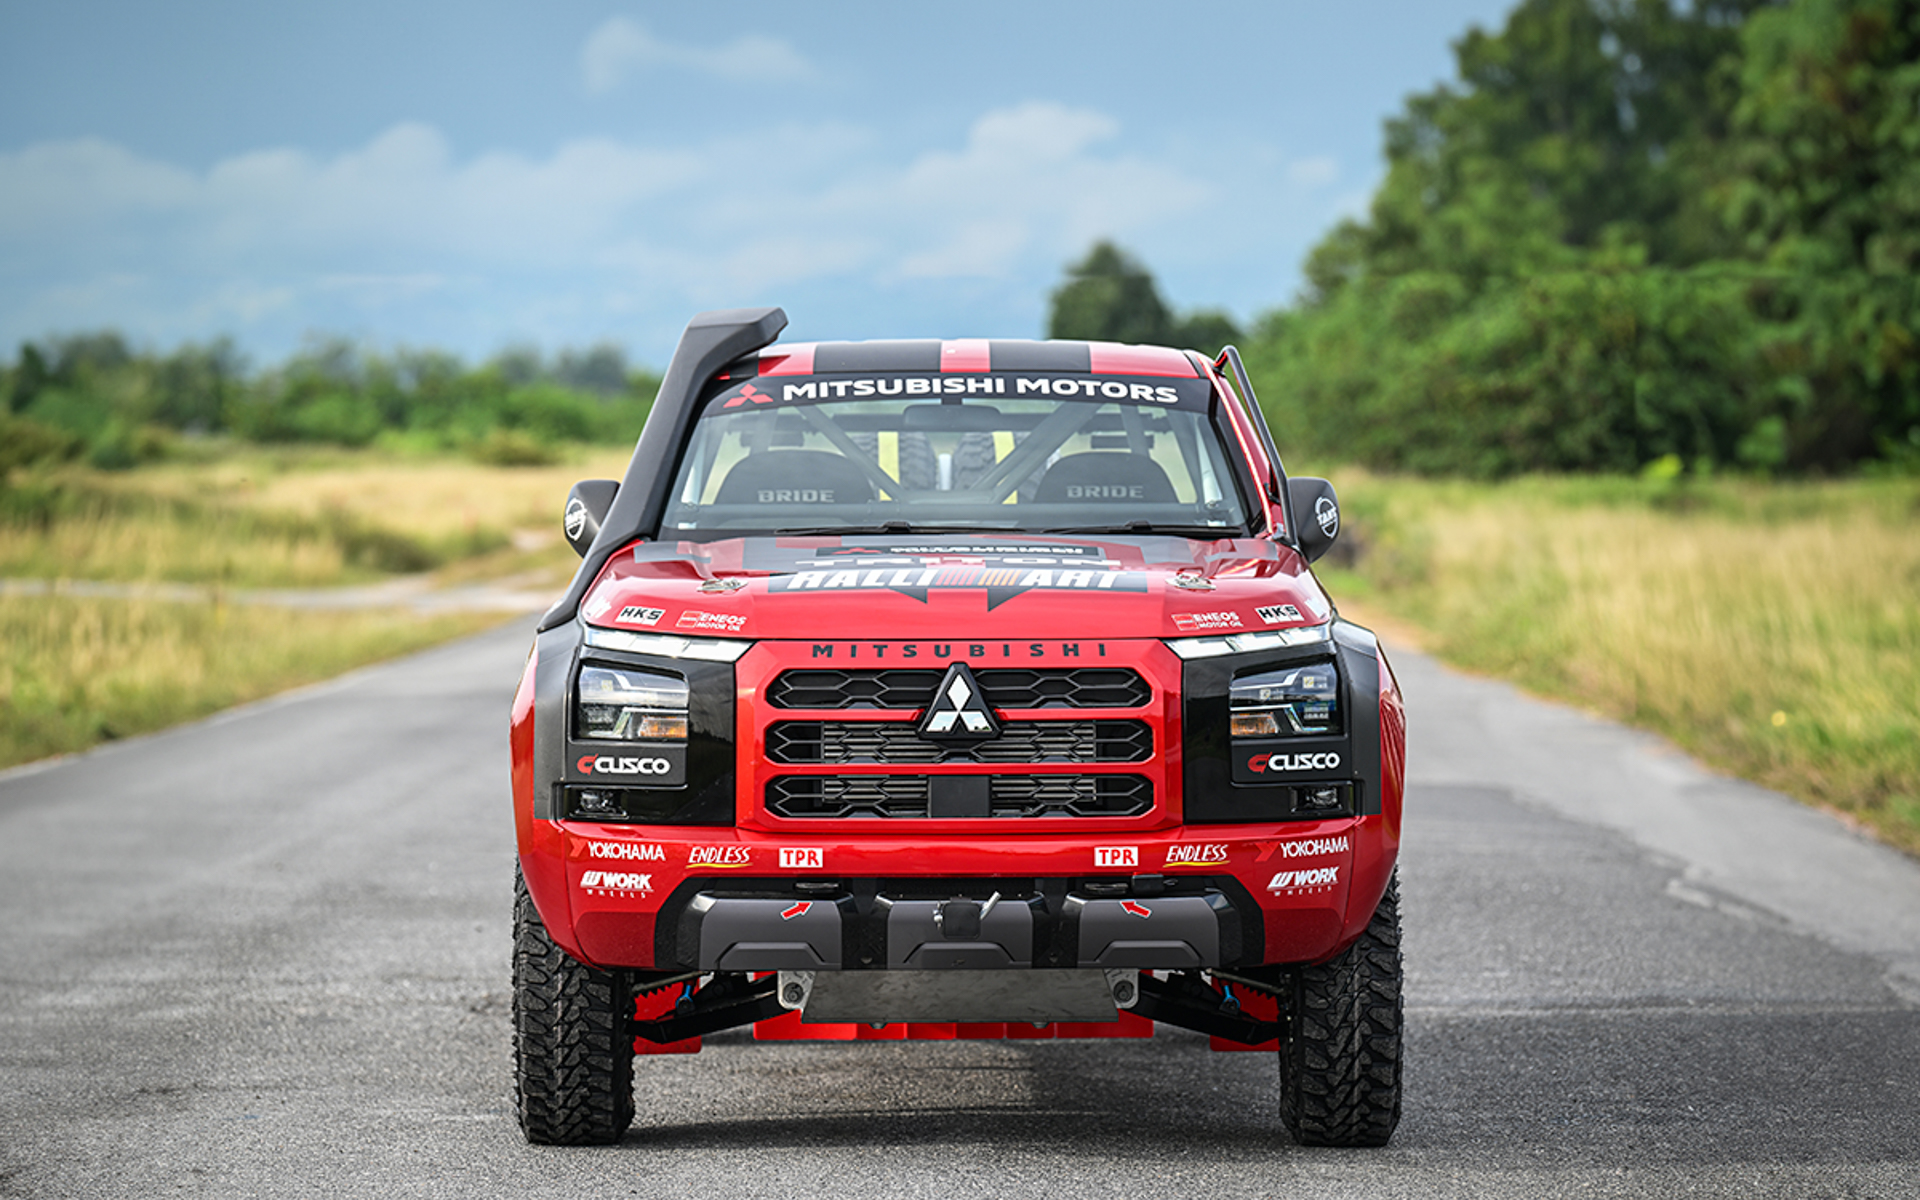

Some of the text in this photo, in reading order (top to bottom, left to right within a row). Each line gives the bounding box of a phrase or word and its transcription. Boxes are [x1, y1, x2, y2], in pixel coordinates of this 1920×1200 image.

[783, 377, 1179, 403] MITSUBISHI MOTORS
[757, 489, 834, 503] BRIDE
[1067, 485, 1144, 498] BRIDE
[620, 607, 664, 620] HKS
[699, 612, 747, 625] ENEOS
[1193, 611, 1240, 622] ENEOS
[1257, 604, 1300, 620] HKS
[696, 621, 727, 630] MOTOR
[812, 643, 1106, 658] MITSUBISHI
[594, 757, 671, 775] CUSCO
[1268, 751, 1341, 772] CUSCO
[587, 841, 666, 862] YOKOHAMA
[1166, 844, 1229, 863] ENDLESS
[1280, 835, 1350, 858] YOKOHAMA
[688, 846, 751, 865] ENDLESS
[783, 850, 819, 867] TPR
[1098, 849, 1135, 865] TPR
[602, 871, 653, 889] WORK
[1294, 866, 1340, 886] WORK
